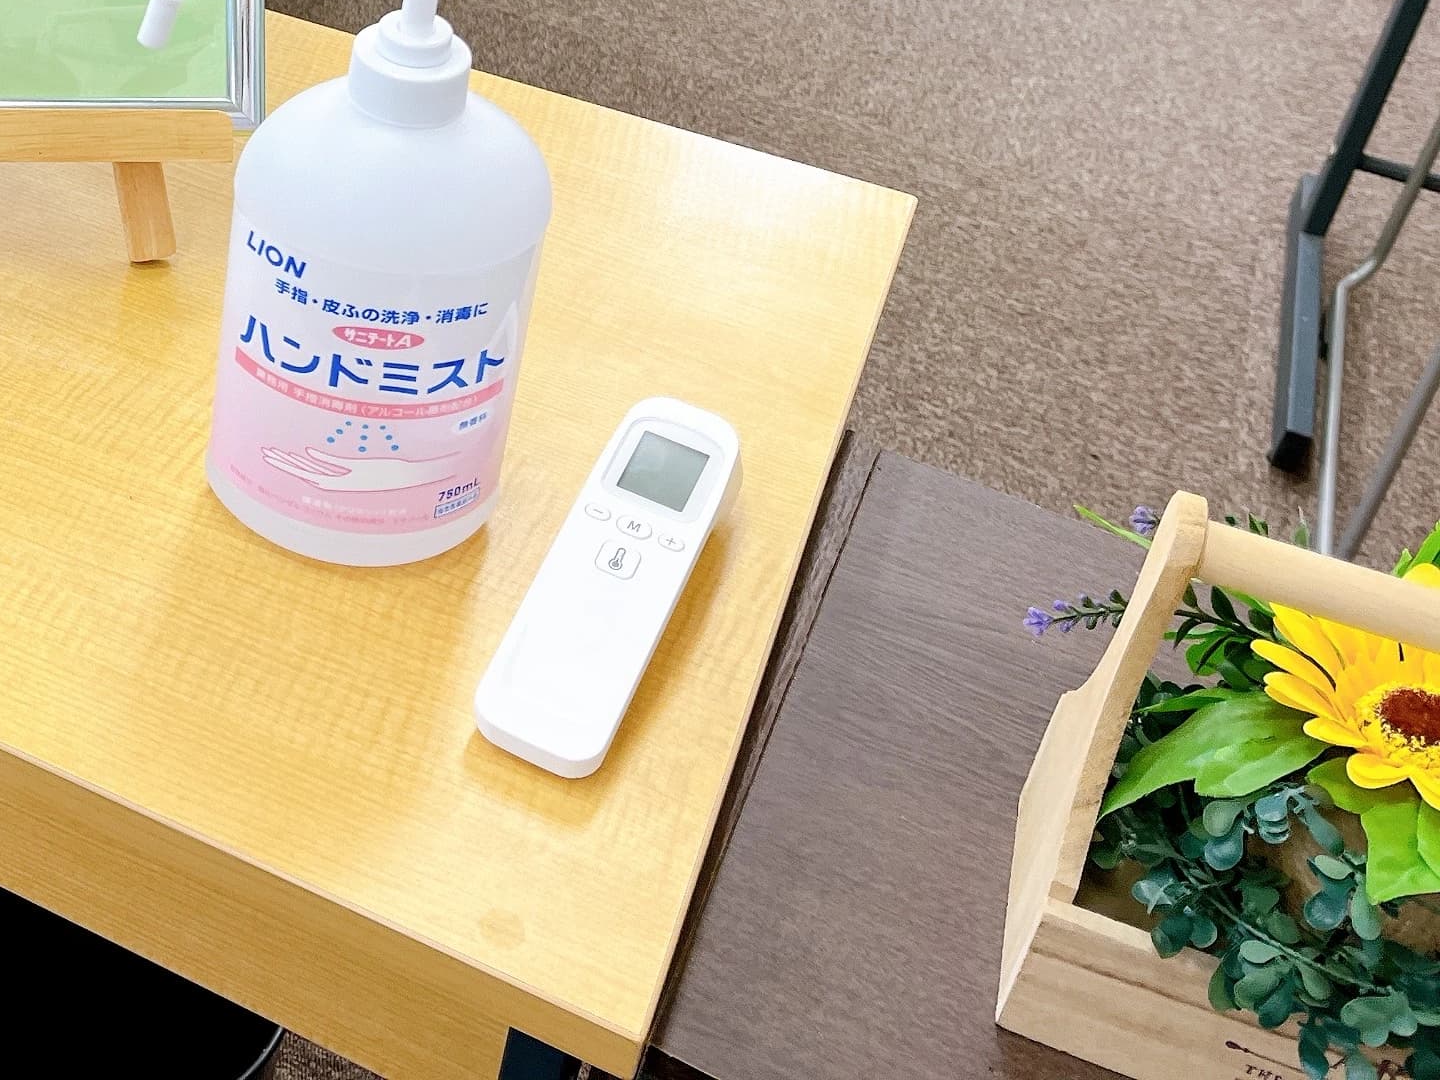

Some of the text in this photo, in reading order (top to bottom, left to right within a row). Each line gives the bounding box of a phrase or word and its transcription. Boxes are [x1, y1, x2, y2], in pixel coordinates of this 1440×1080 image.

[246, 230, 307, 279] LION
[274, 278, 489, 325] 手指・皮ふの洗浄・消毒に
[240, 315, 505, 396] ハンドミスト
[343, 327, 411, 349] サニテートA
[438, 477, 481, 502] 750mL
[626, 520, 642, 533] M
